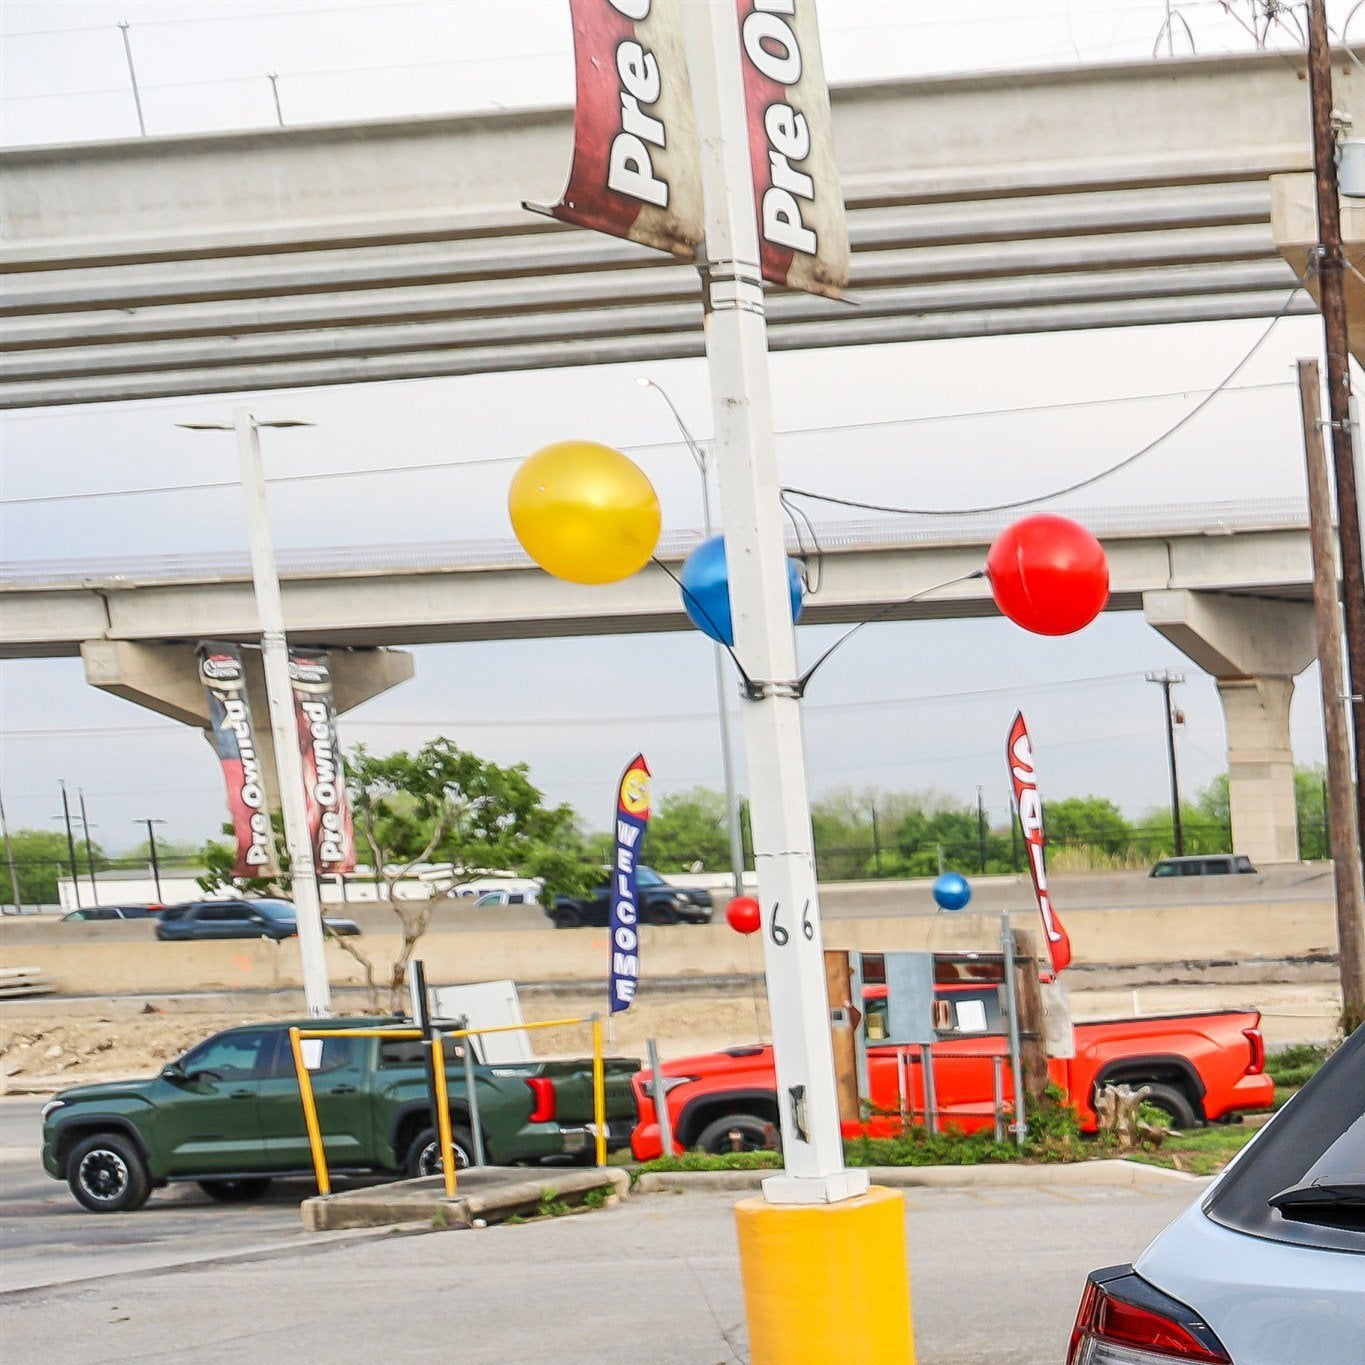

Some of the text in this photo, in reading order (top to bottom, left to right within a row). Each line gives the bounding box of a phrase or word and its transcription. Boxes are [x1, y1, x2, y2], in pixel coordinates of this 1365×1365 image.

[608, 40, 669, 208] Pre
[762, 102, 818, 256] Pre
[302, 701, 338, 808] Owned
[246, 812, 270, 865] Pre
[320, 810, 345, 863] Pre
[614, 819, 640, 1002] WELCOME
